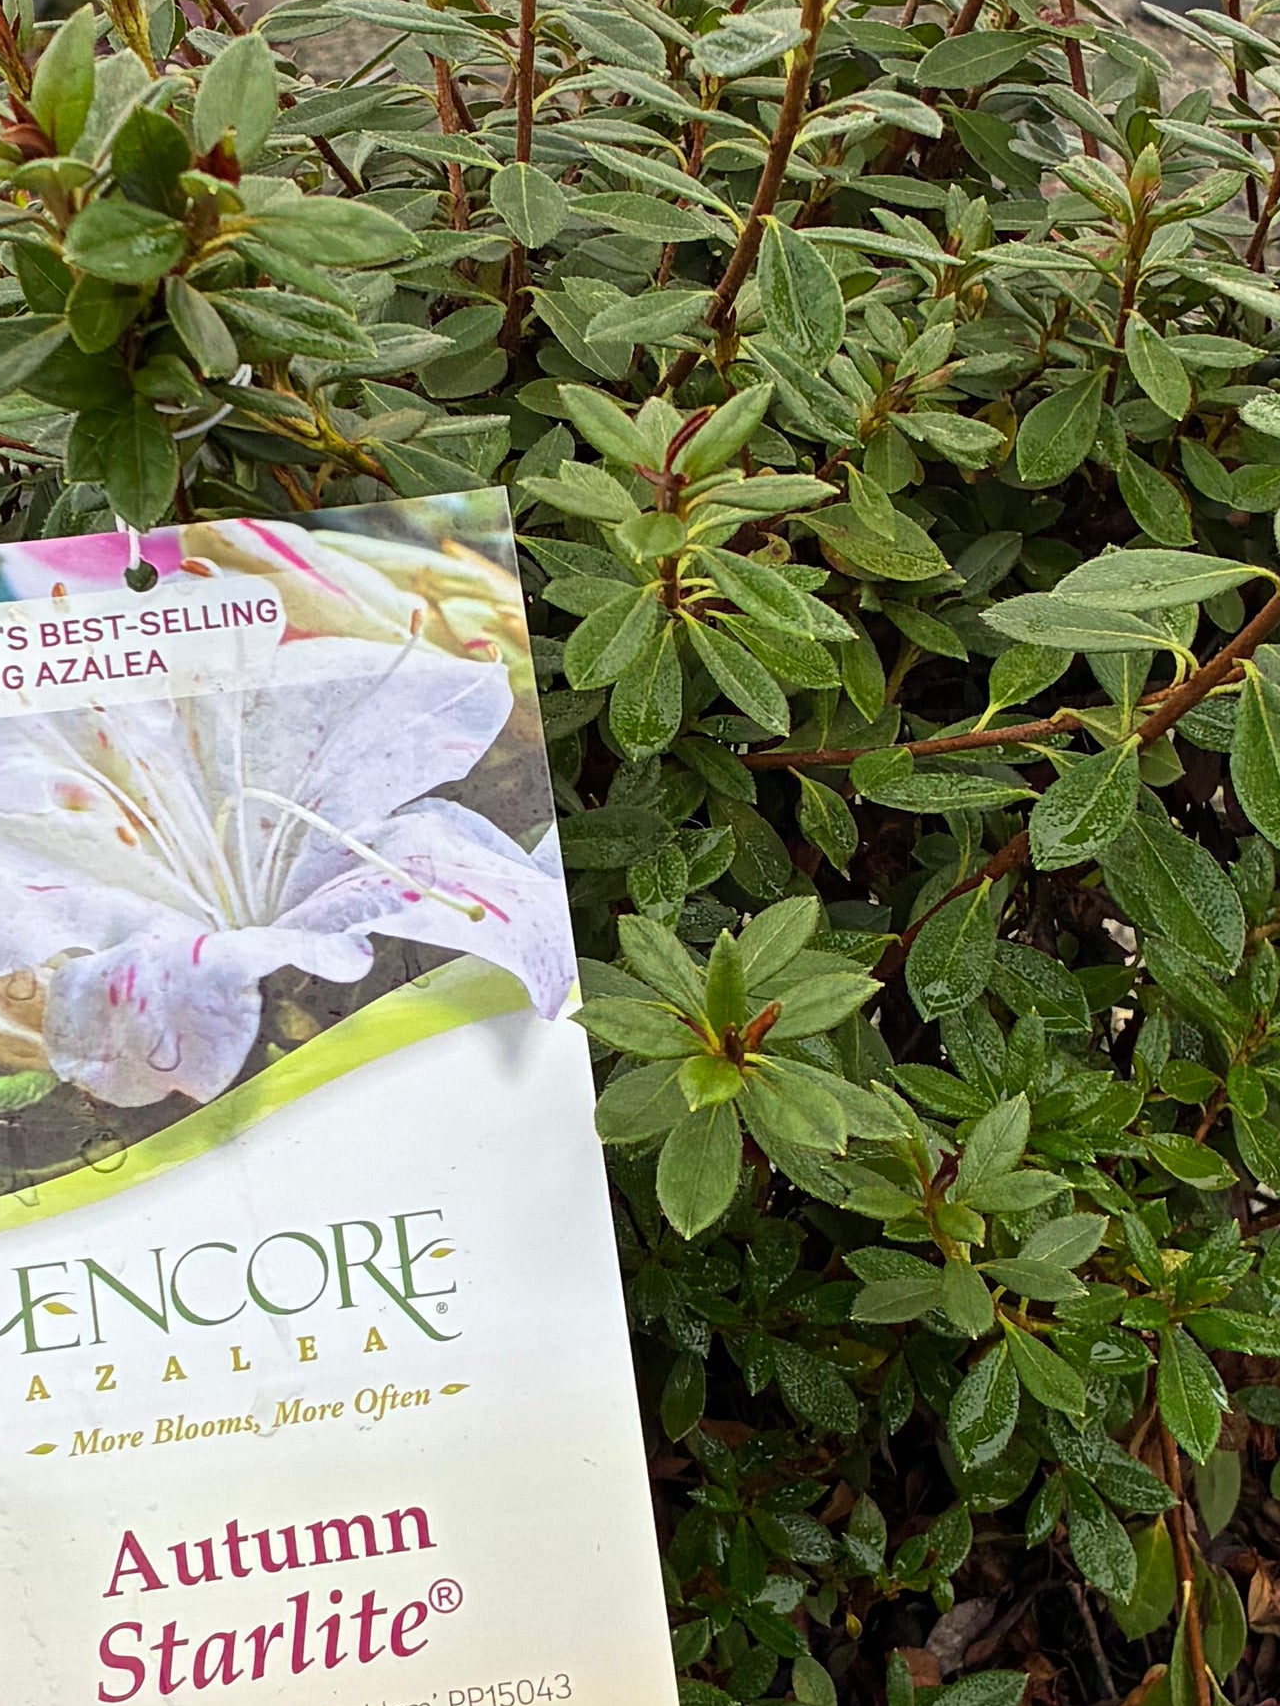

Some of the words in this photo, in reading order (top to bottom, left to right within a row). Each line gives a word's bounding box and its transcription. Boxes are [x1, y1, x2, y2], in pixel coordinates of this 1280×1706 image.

[39, 598, 279, 648] BEST-SELLING
[35, 650, 168, 688] AZALEA
[25, 1326, 388, 1403] AZALEA
[68, 1428, 144, 1457] More
[152, 1412, 263, 1447] Blooms,
[272, 1397, 344, 1429] More
[354, 1384, 431, 1421] Often
[102, 1504, 437, 1598] Autumn
